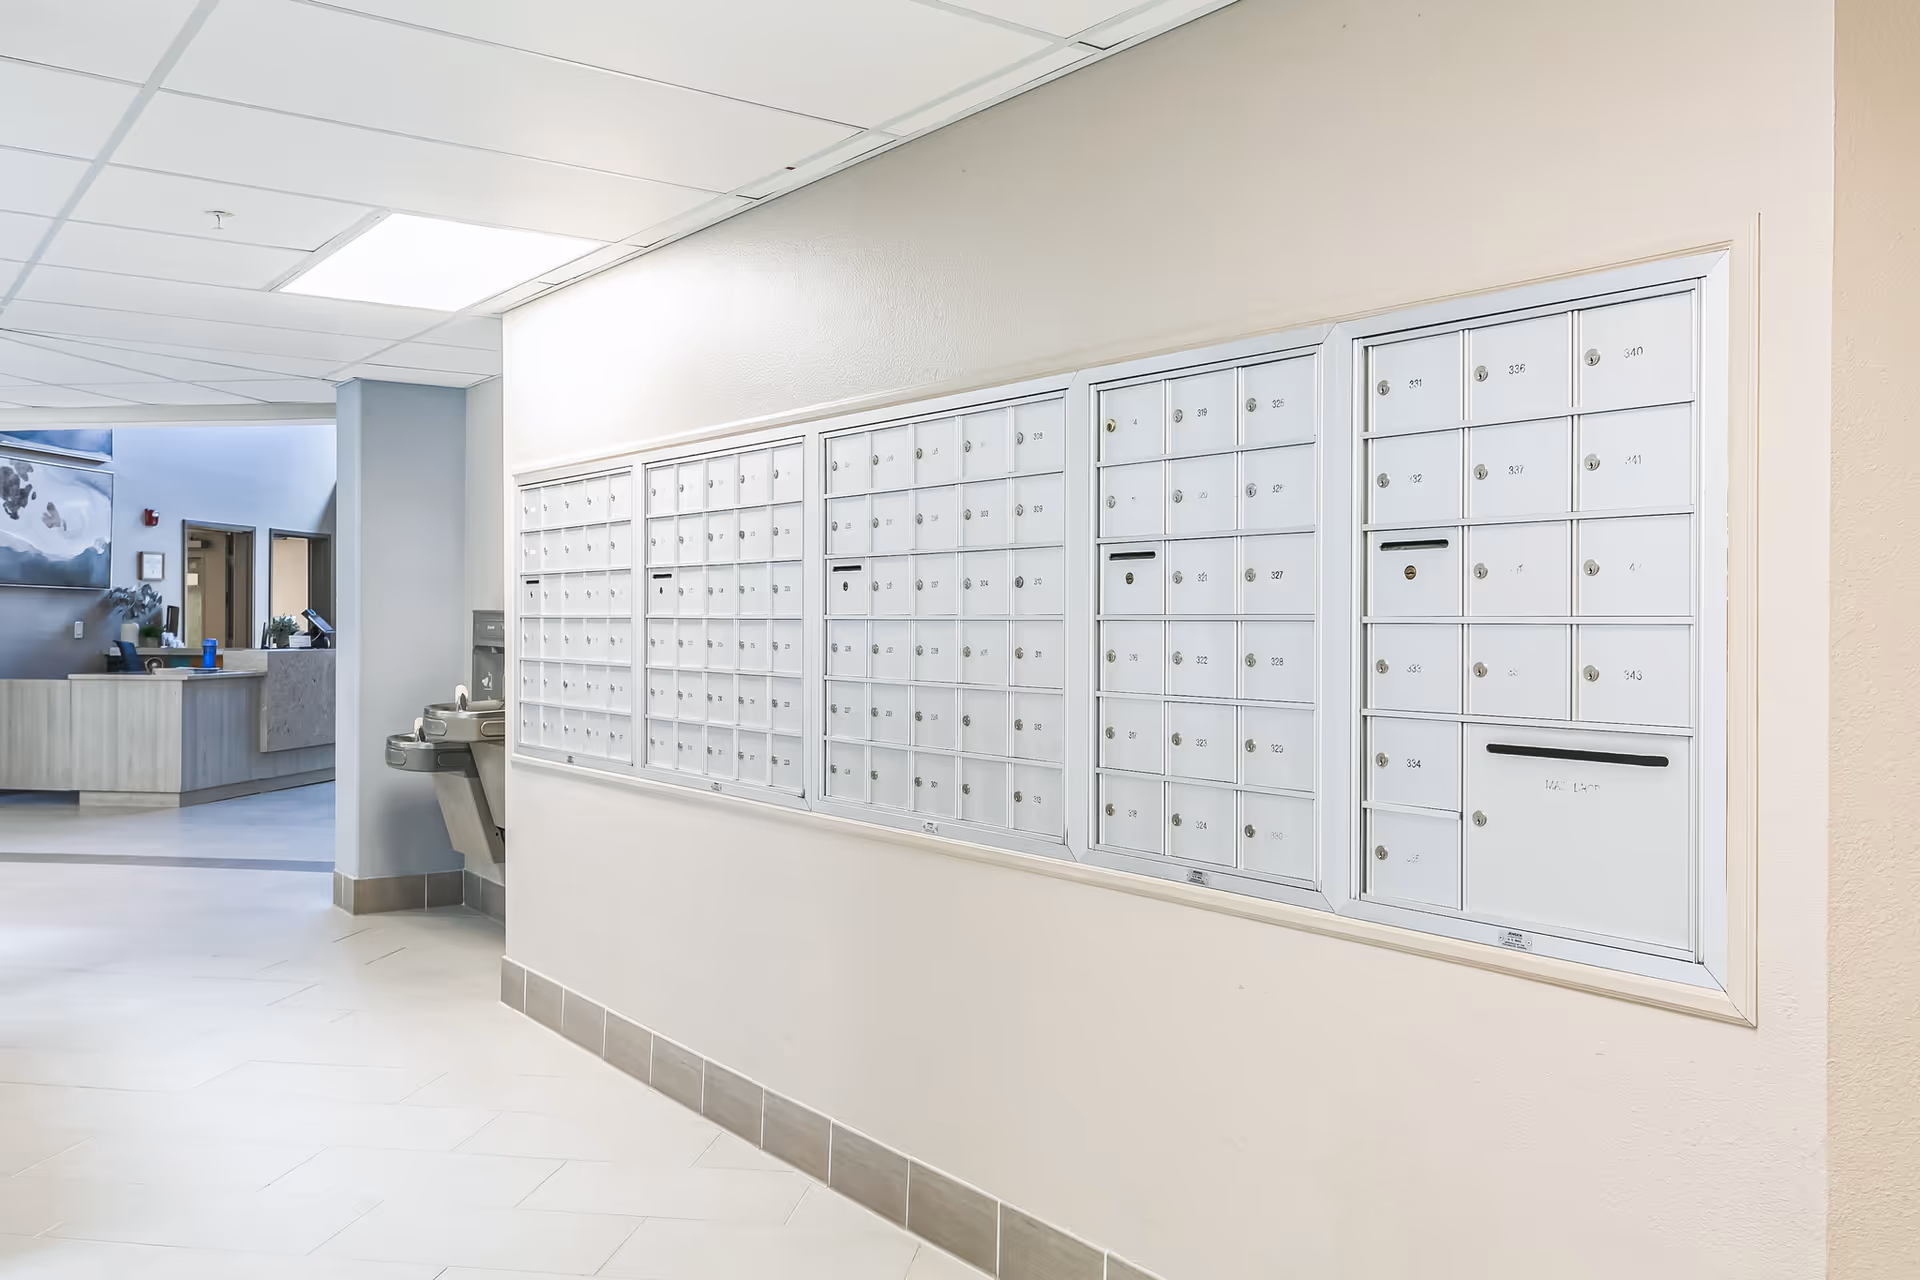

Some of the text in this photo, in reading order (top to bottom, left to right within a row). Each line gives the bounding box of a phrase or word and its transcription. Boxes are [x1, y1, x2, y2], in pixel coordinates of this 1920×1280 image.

[1624, 346, 1643, 359] 340
[1509, 363, 1525, 375] 336
[1409, 379, 1422, 389] 331
[1272, 398, 1284, 409] 325
[1197, 408, 1208, 417] 319
[1508, 465, 1524, 475] 337
[1408, 473, 1422, 483] 32
[1197, 572, 1207, 582] 321
[1271, 570, 1283, 580] 327
[1196, 656, 1208, 665] 322
[1271, 657, 1284, 666] 328
[1624, 670, 1642, 681] 343
[1406, 758, 1421, 768] 334
[1545, 779, 1570, 791] MA
[1196, 821, 1207, 829] 324
